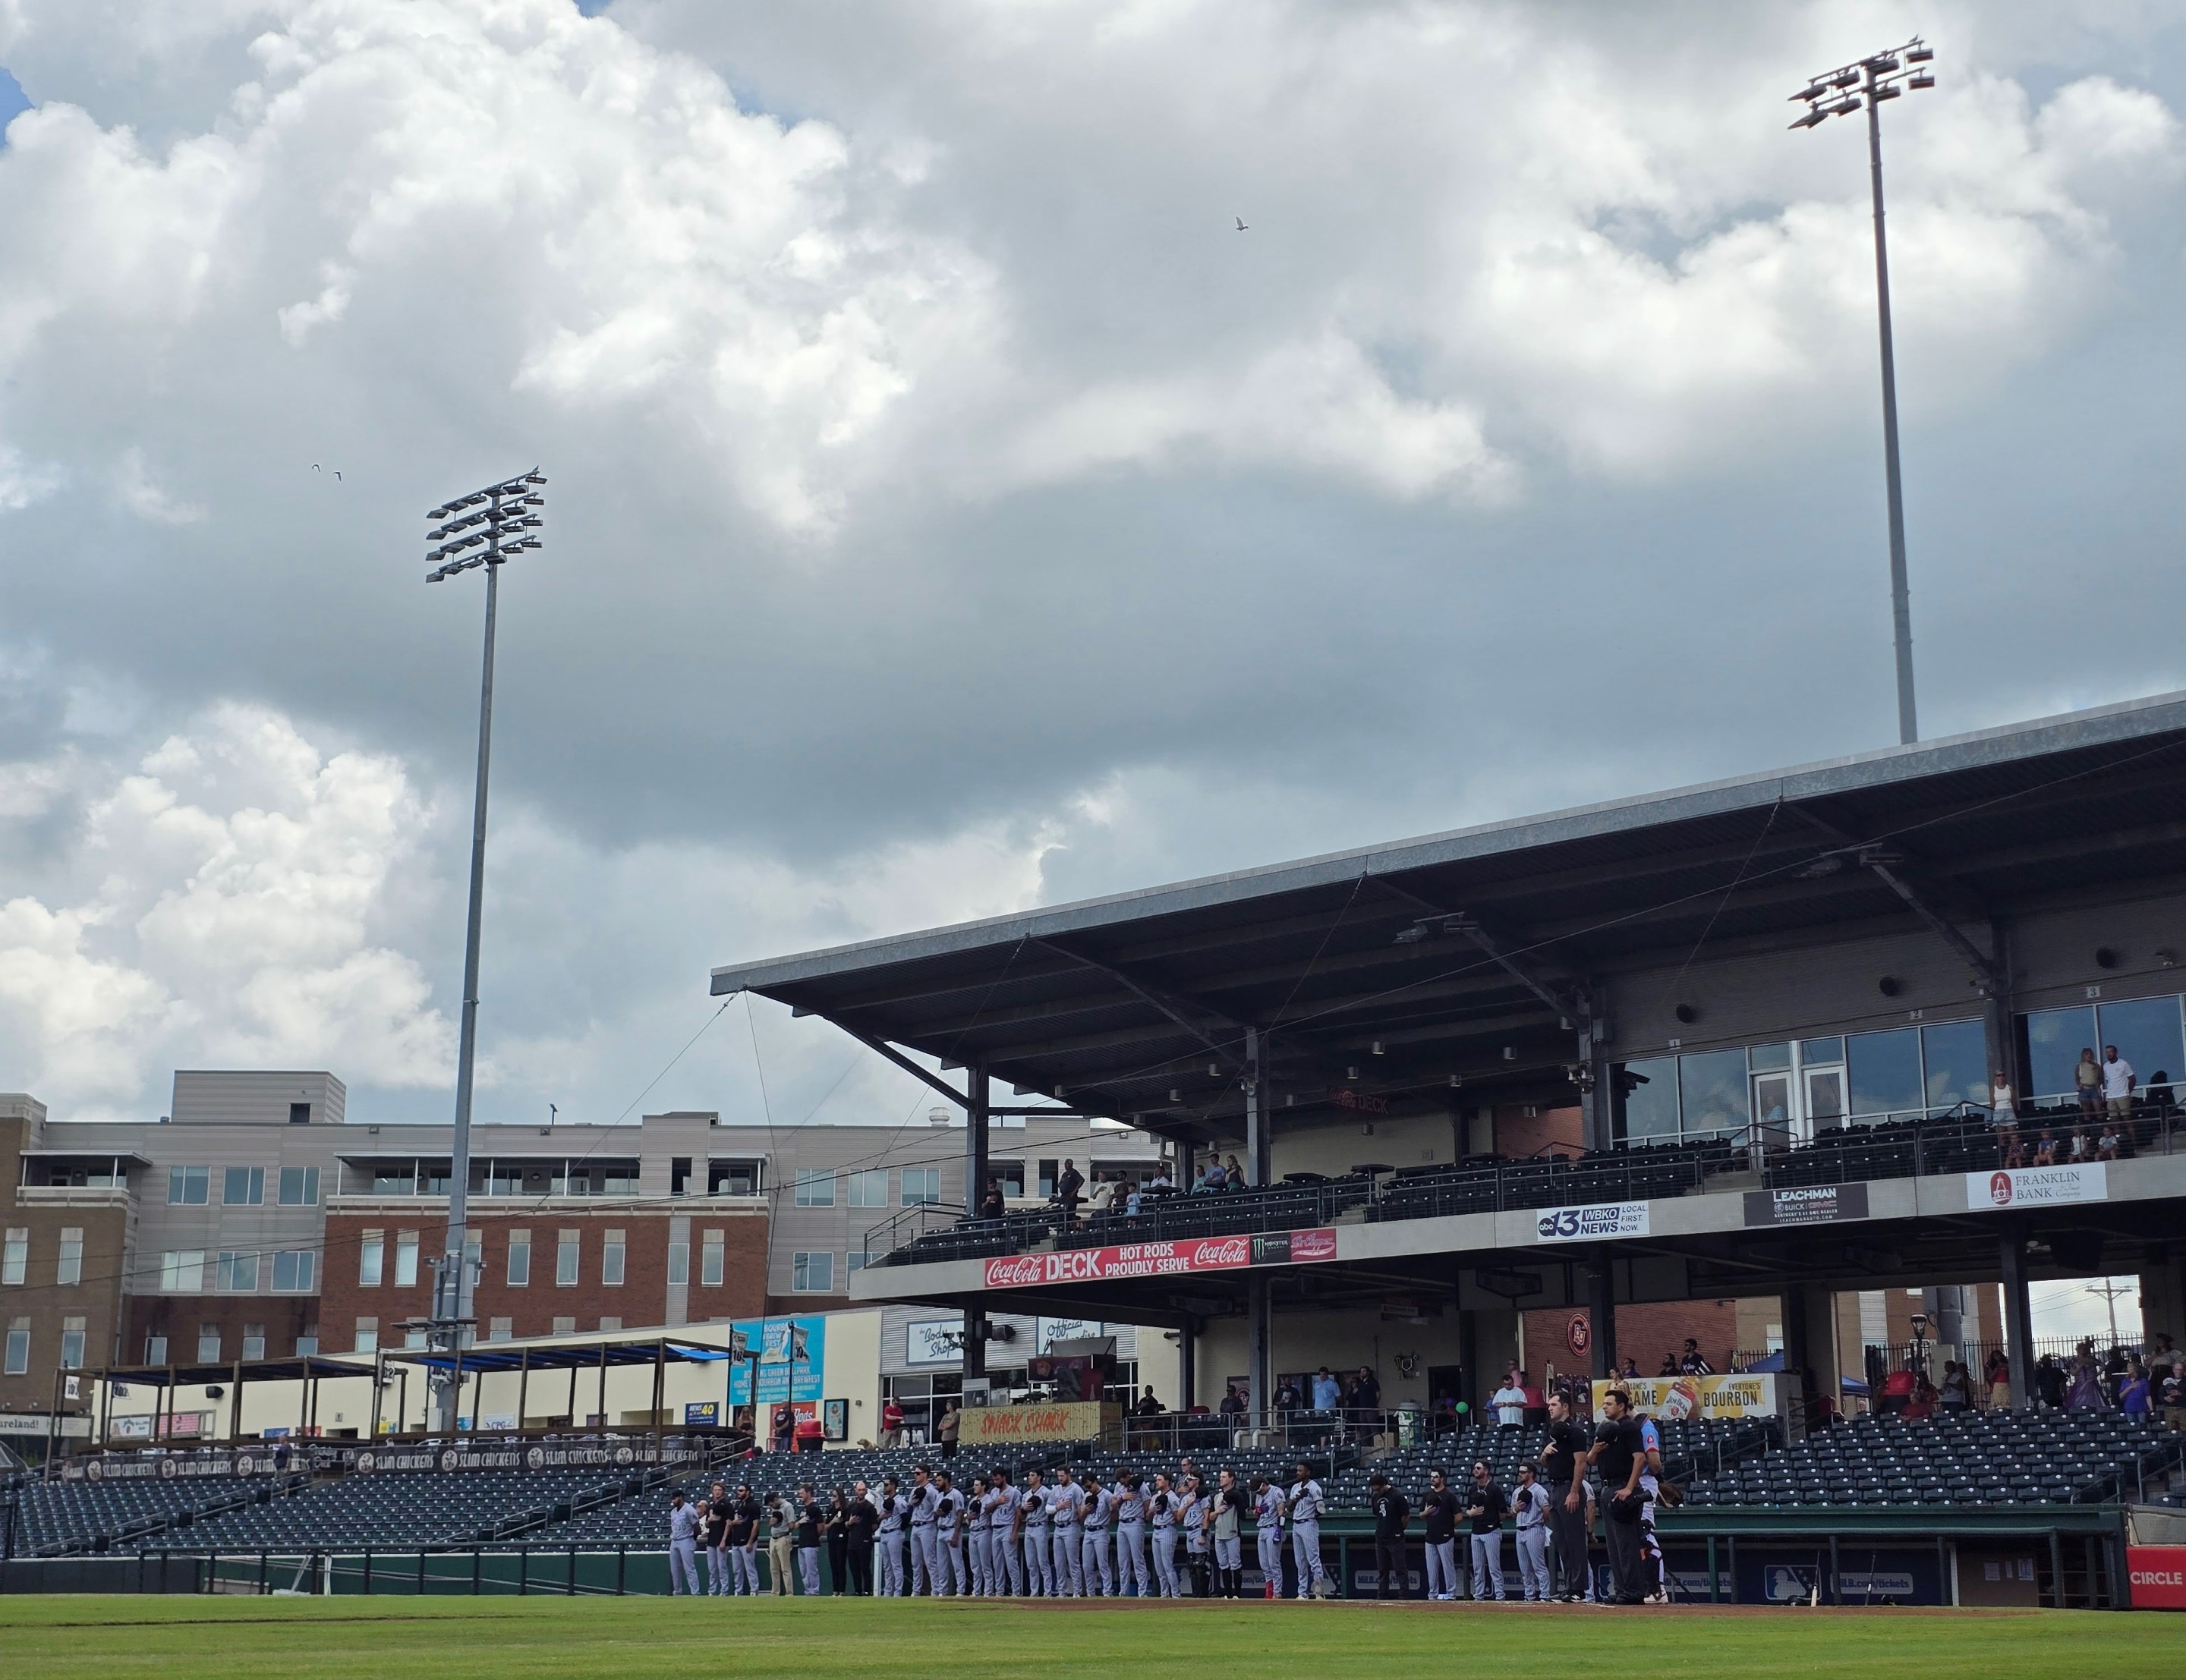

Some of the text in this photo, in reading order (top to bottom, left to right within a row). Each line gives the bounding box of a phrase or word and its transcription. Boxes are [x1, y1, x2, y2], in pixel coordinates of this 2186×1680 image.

[1359, 1096, 1388, 1115] DECK
[2016, 1172, 2080, 1186] FRANKLIN
[1773, 1188, 1837, 1203] LEACHMAN
[2017, 1188, 2052, 1199] BANK
[1584, 1209, 1617, 1221] WBKO
[1551, 1210, 1580, 1236] 13
[1580, 1222, 1618, 1235] NEWS
[1120, 1243, 1174, 1260] HOT RODS
[1195, 1238, 1249, 1265] Coca-Cola
[987, 1251, 1102, 1285] Coca-Cola DECK
[1105, 1257, 1189, 1277] PROUDLY SERVE
[924, 1324, 947, 1344] Body
[1047, 1320, 1082, 1338] Official
[784, 1366, 811, 1376] BLLPARK
[759, 1377, 781, 1387] OURBON
[1728, 1382, 1761, 1391] EVERYONE'S
[1630, 1390, 1758, 1407] AME BOURBON
[701, 1404, 714, 1415] 40
[981, 1411, 1069, 1434] SNACK SHACK
[375, 1455, 434, 1469] SLIM CHICKENS
[459, 1452, 521, 1467] SLIM CHICKENS
[546, 1449, 607, 1464] SLIM CHICKENS
[635, 1449, 699, 1461] SLIM HICKENS
[2130, 1571, 2183, 1585] CIRCLE
